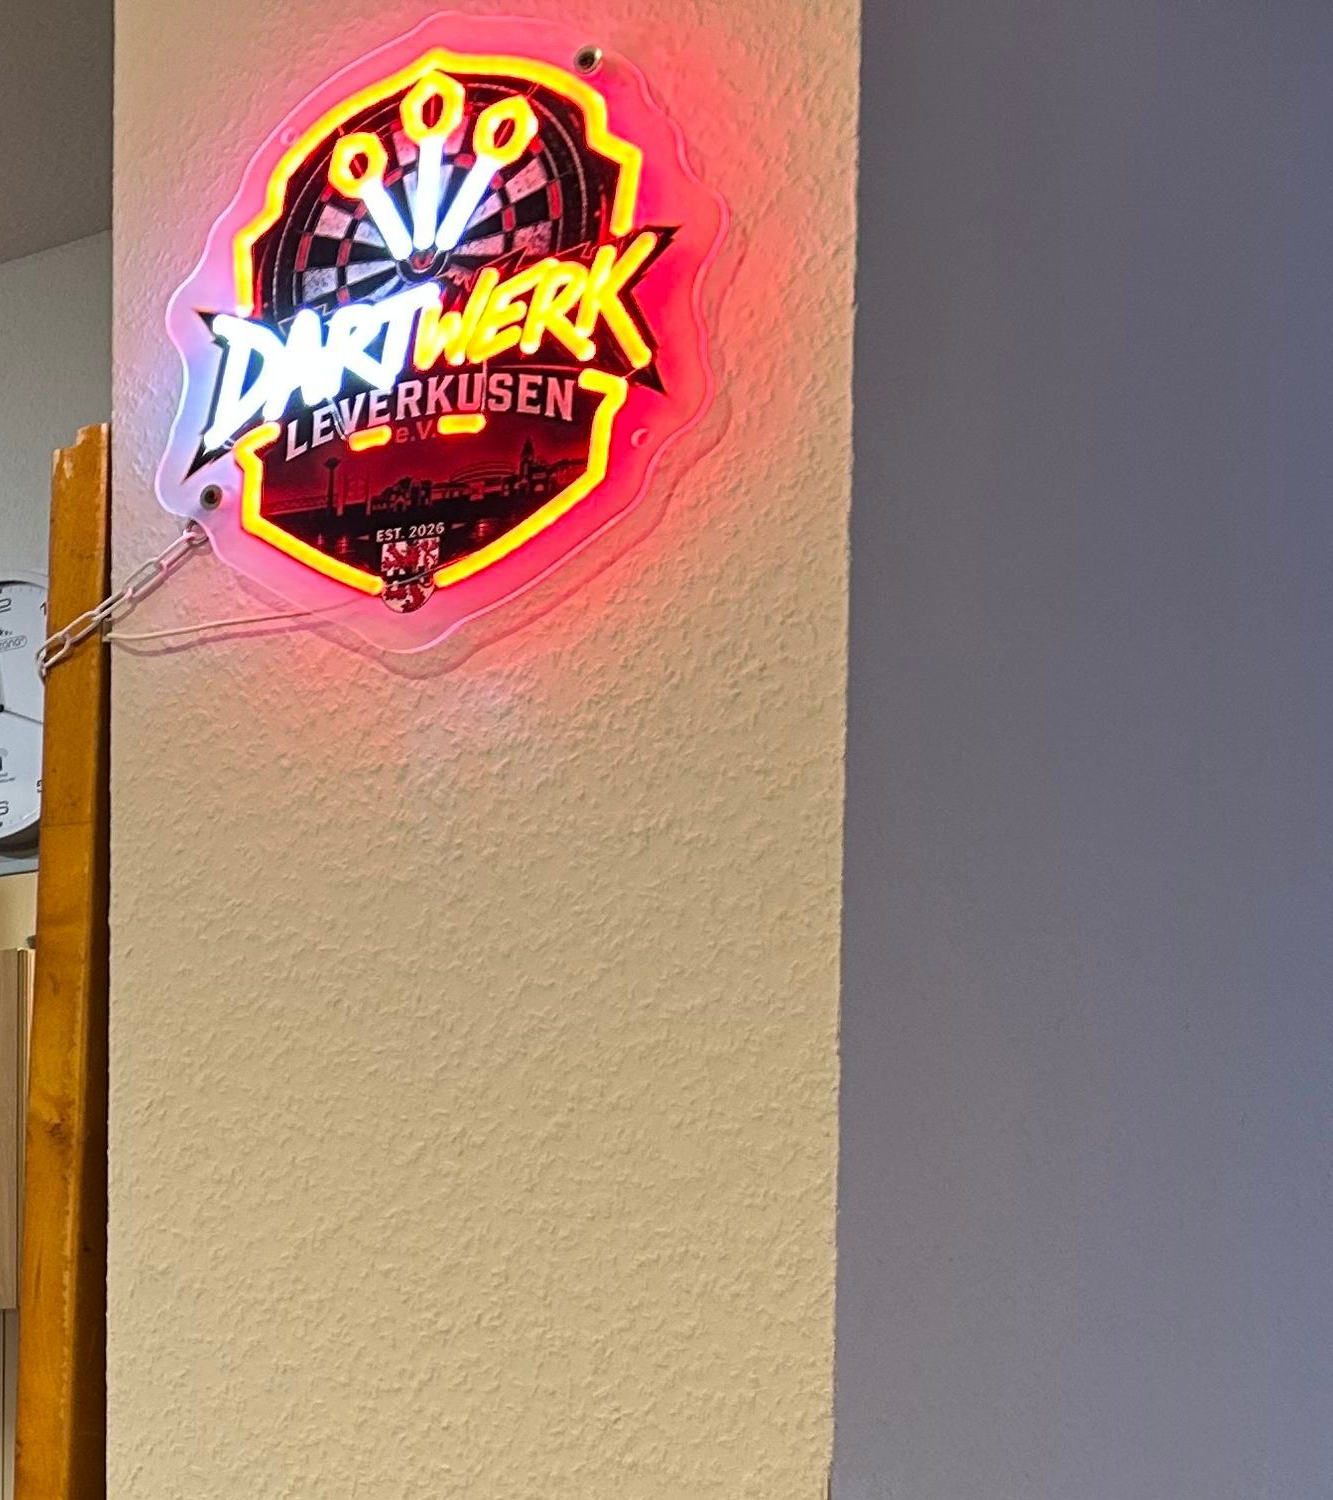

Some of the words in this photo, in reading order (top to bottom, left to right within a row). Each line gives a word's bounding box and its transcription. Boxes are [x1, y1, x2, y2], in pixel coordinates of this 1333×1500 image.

[204, 230, 658, 453] DARTWERK
[285, 371, 575, 462] LEVERKUSEN
[376, 526, 405, 543] EST.
[408, 521, 446, 538] 2026
